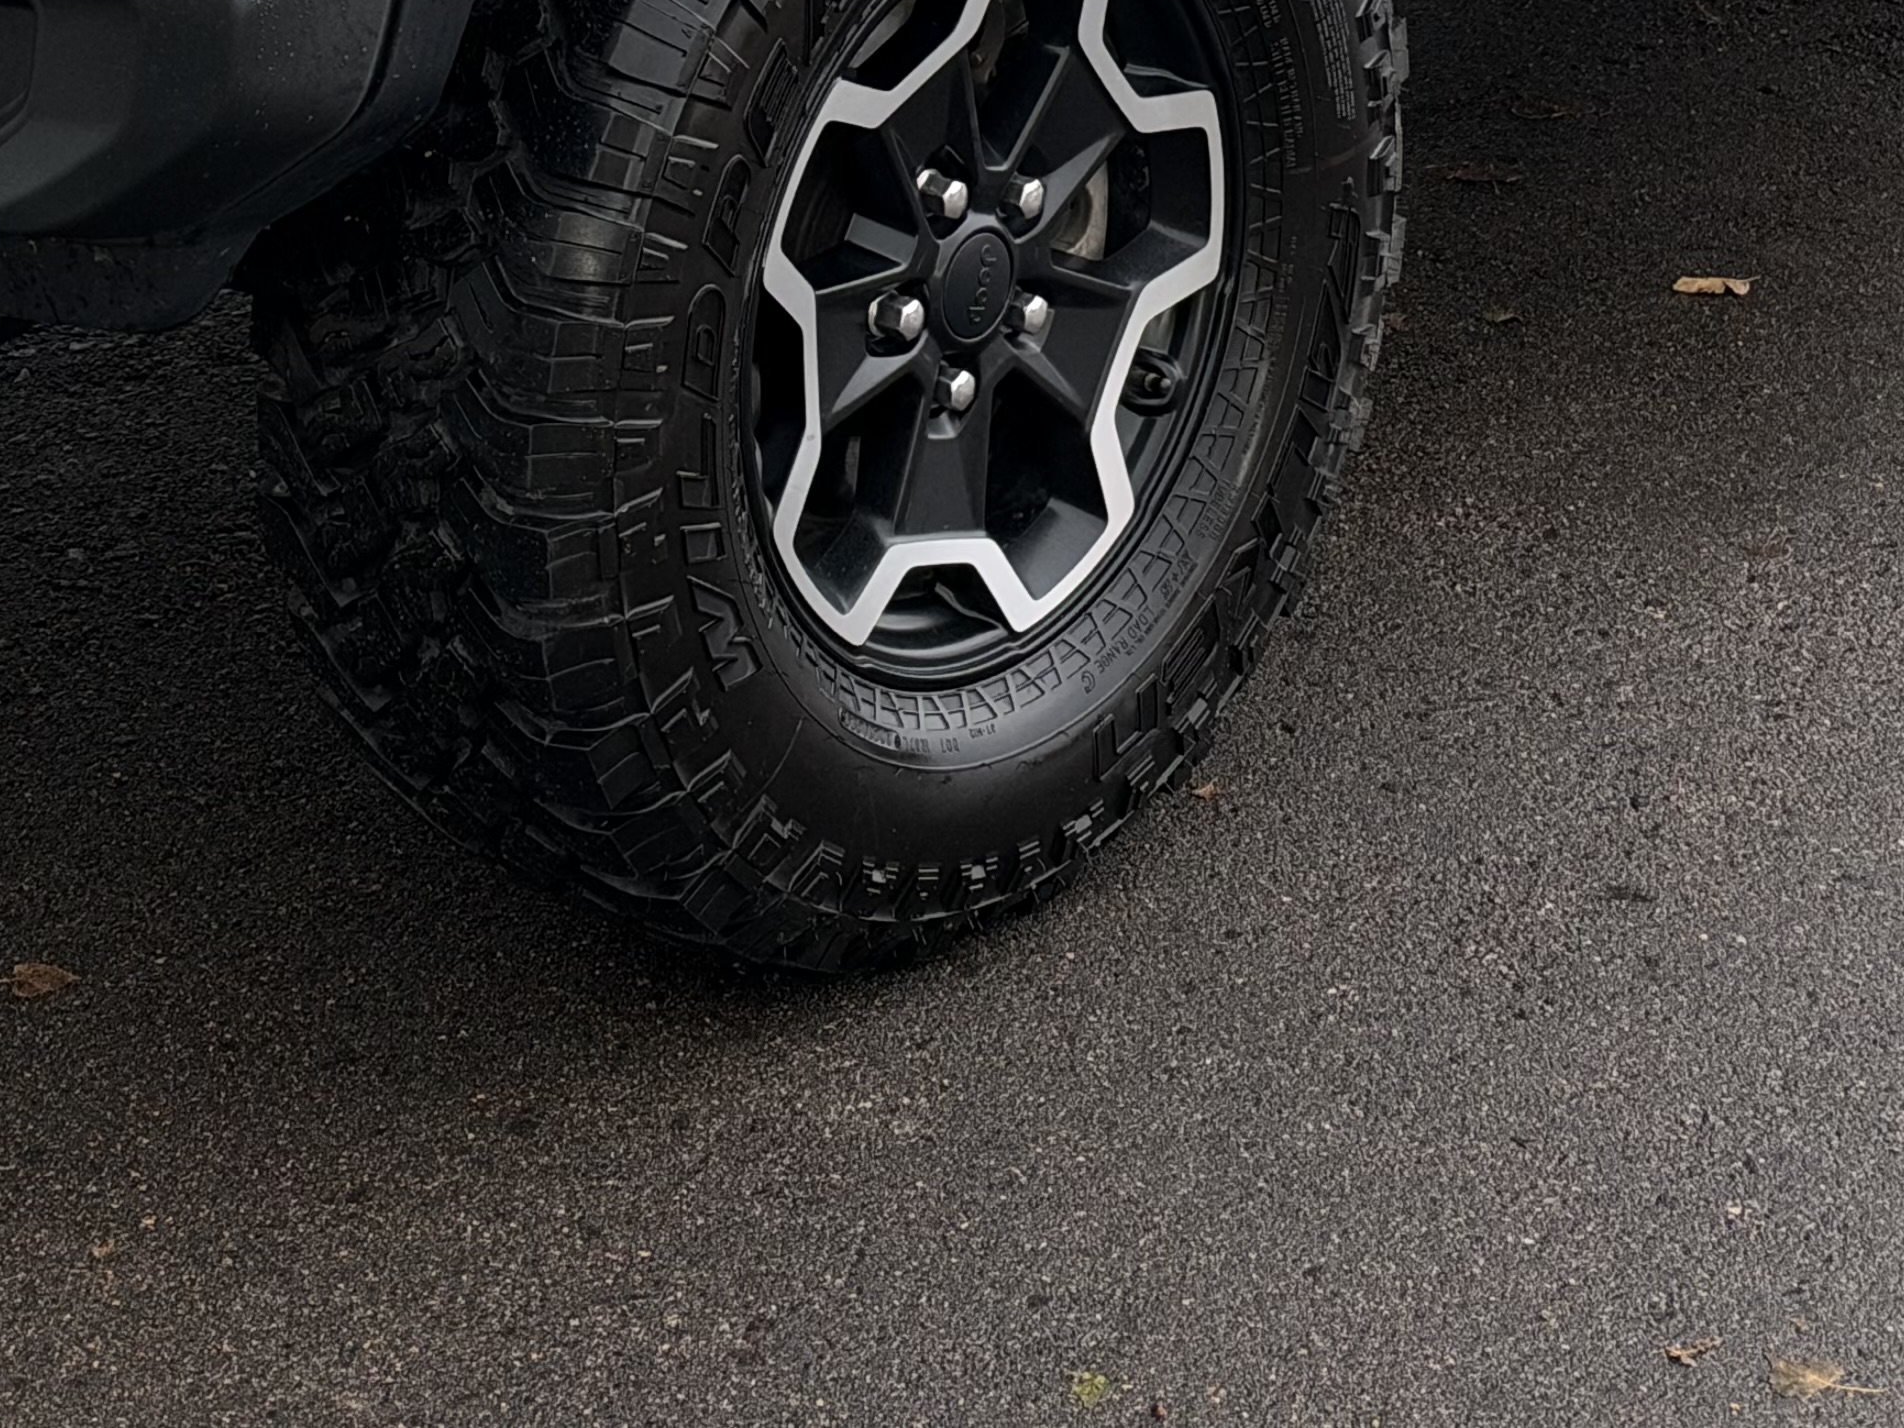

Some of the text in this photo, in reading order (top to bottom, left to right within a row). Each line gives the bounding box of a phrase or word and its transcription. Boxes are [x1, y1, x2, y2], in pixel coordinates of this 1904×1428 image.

[969, 244, 997, 322] Jeep
[1128, 606, 1155, 640] LOAD
[1097, 639, 1130, 674] RANGE
